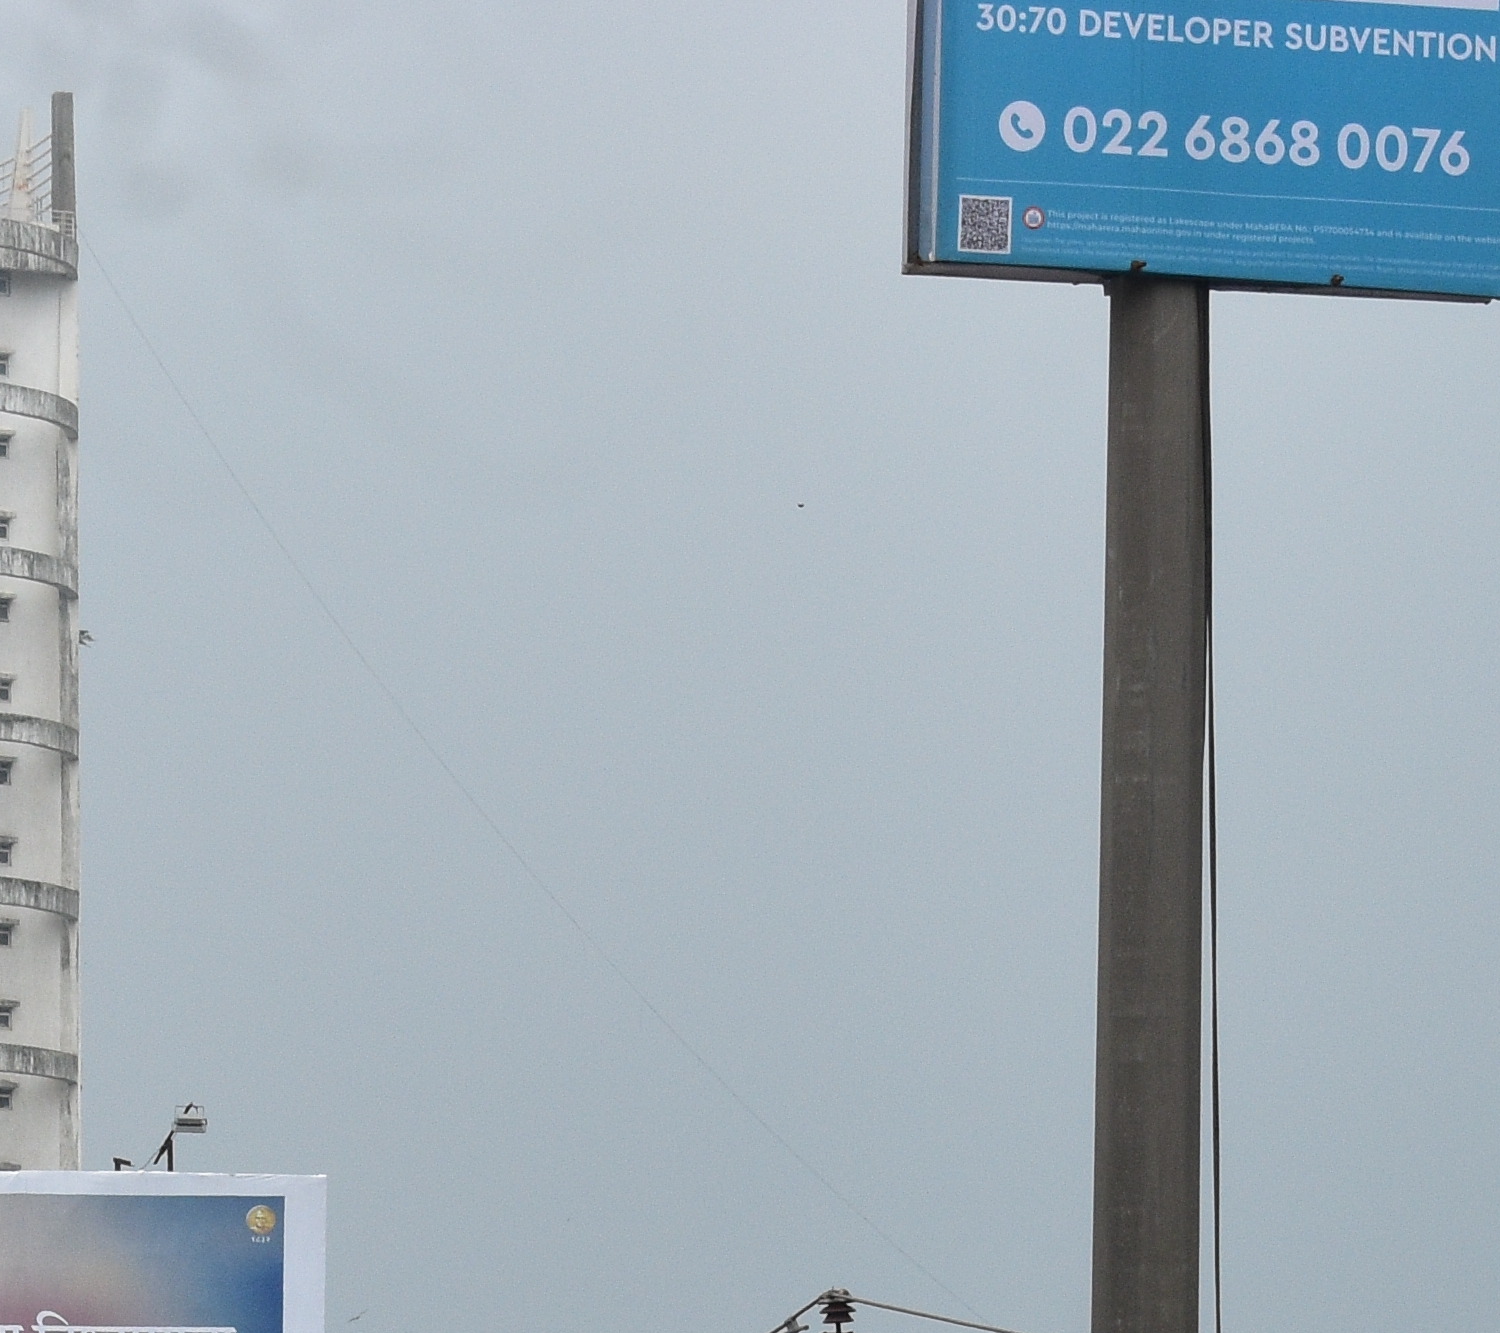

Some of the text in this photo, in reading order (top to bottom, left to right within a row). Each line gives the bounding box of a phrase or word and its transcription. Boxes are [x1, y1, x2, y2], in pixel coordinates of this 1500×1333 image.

[977, 3, 1497, 62] 30:70 DEVELOPER SUBVENTION
[1063, 105, 1471, 176] 022 6868 0076
[1047, 209, 1065, 219] This
[1067, 211, 1098, 221] project
[1110, 214, 1155, 225] registered
[1217, 221, 1242, 229] under
[1377, 229, 1394, 238] and
[1404, 231, 1442, 241] available
[1457, 234, 1472, 242] the
[1204, 230, 1230, 239] under
[1232, 233, 1277, 243] registered
